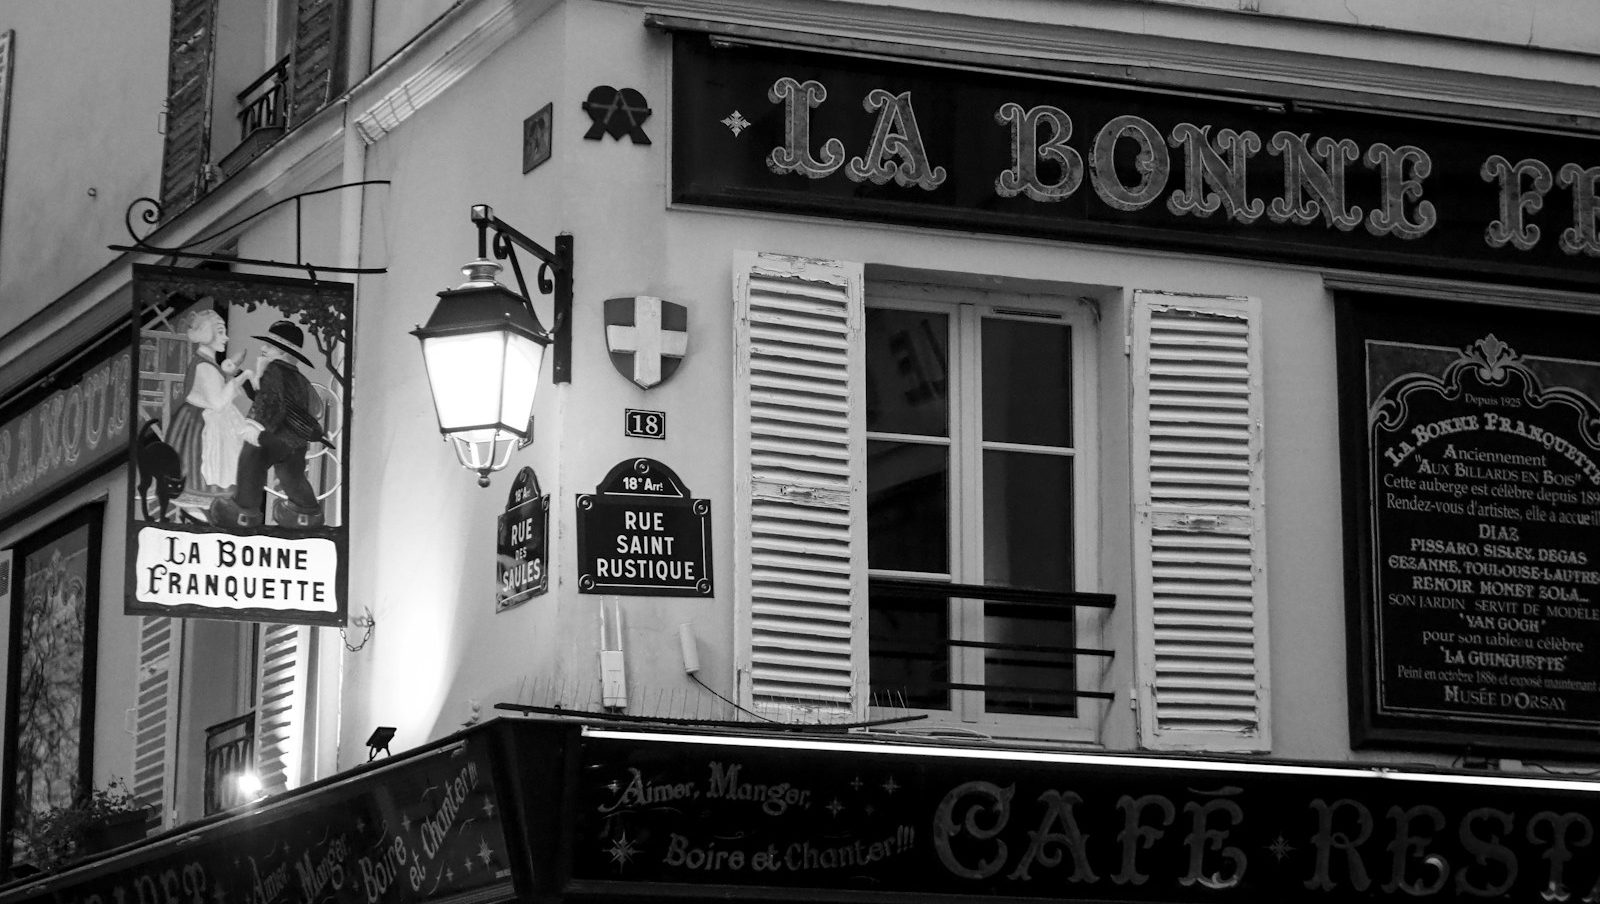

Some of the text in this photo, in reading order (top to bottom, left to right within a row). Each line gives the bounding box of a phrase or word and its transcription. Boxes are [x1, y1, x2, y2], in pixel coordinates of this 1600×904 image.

[766, 77, 947, 192] LA
[994, 102, 1437, 240] BONNE
[1465, 393, 1498, 408] Depuis
[632, 414, 659, 435] 18
[1384, 441, 1416, 467] LA
[1411, 414, 1480, 447] BONNE
[1443, 444, 1547, 467] Anciennement
[1454, 462, 1519, 482] BILLARDS
[1521, 471, 1540, 484] EN
[1383, 473, 1416, 490] Cette
[1418, 477, 1469, 499] auberge
[1470, 483, 1488, 496] est
[1490, 483, 1535, 501] célèbre
[1536, 486, 1578, 507] depuis
[1386, 493, 1465, 515] Rendez-vous
[1525, 504, 1547, 522] elle
[1548, 510, 1557, 523] a
[511, 517, 533, 546] RUE
[624, 511, 664, 531] RUE
[1478, 523, 1520, 542] DIAZ
[165, 536, 308, 570] LA BONNE
[515, 546, 528, 561] DES
[616, 535, 674, 555] SAINT
[1538, 547, 1588, 565] DEGAS
[502, 558, 541, 592] SAULES
[596, 558, 695, 581] RUSTIQUE
[143, 564, 325, 601] FRANQUETTE
[1388, 593, 1416, 607] SON
[1419, 595, 1466, 610] JARDIN
[1474, 600, 1519, 615] SERVIT
[1522, 602, 1541, 616] DE
[1422, 630, 1584, 653] pour son tableau célèbre
[1397, 664, 1422, 680] Peint
[1424, 670, 1437, 680] en
[1438, 668, 1474, 683] octobre
[1443, 685, 1567, 712] MUSÉE D'ORSAY
[662, 832, 746, 871] Boire
[751, 844, 781, 872] et
[932, 780, 1600, 903] CAFÉ REST
[358, 835, 407, 904] Boire
[410, 849, 426, 892] et
